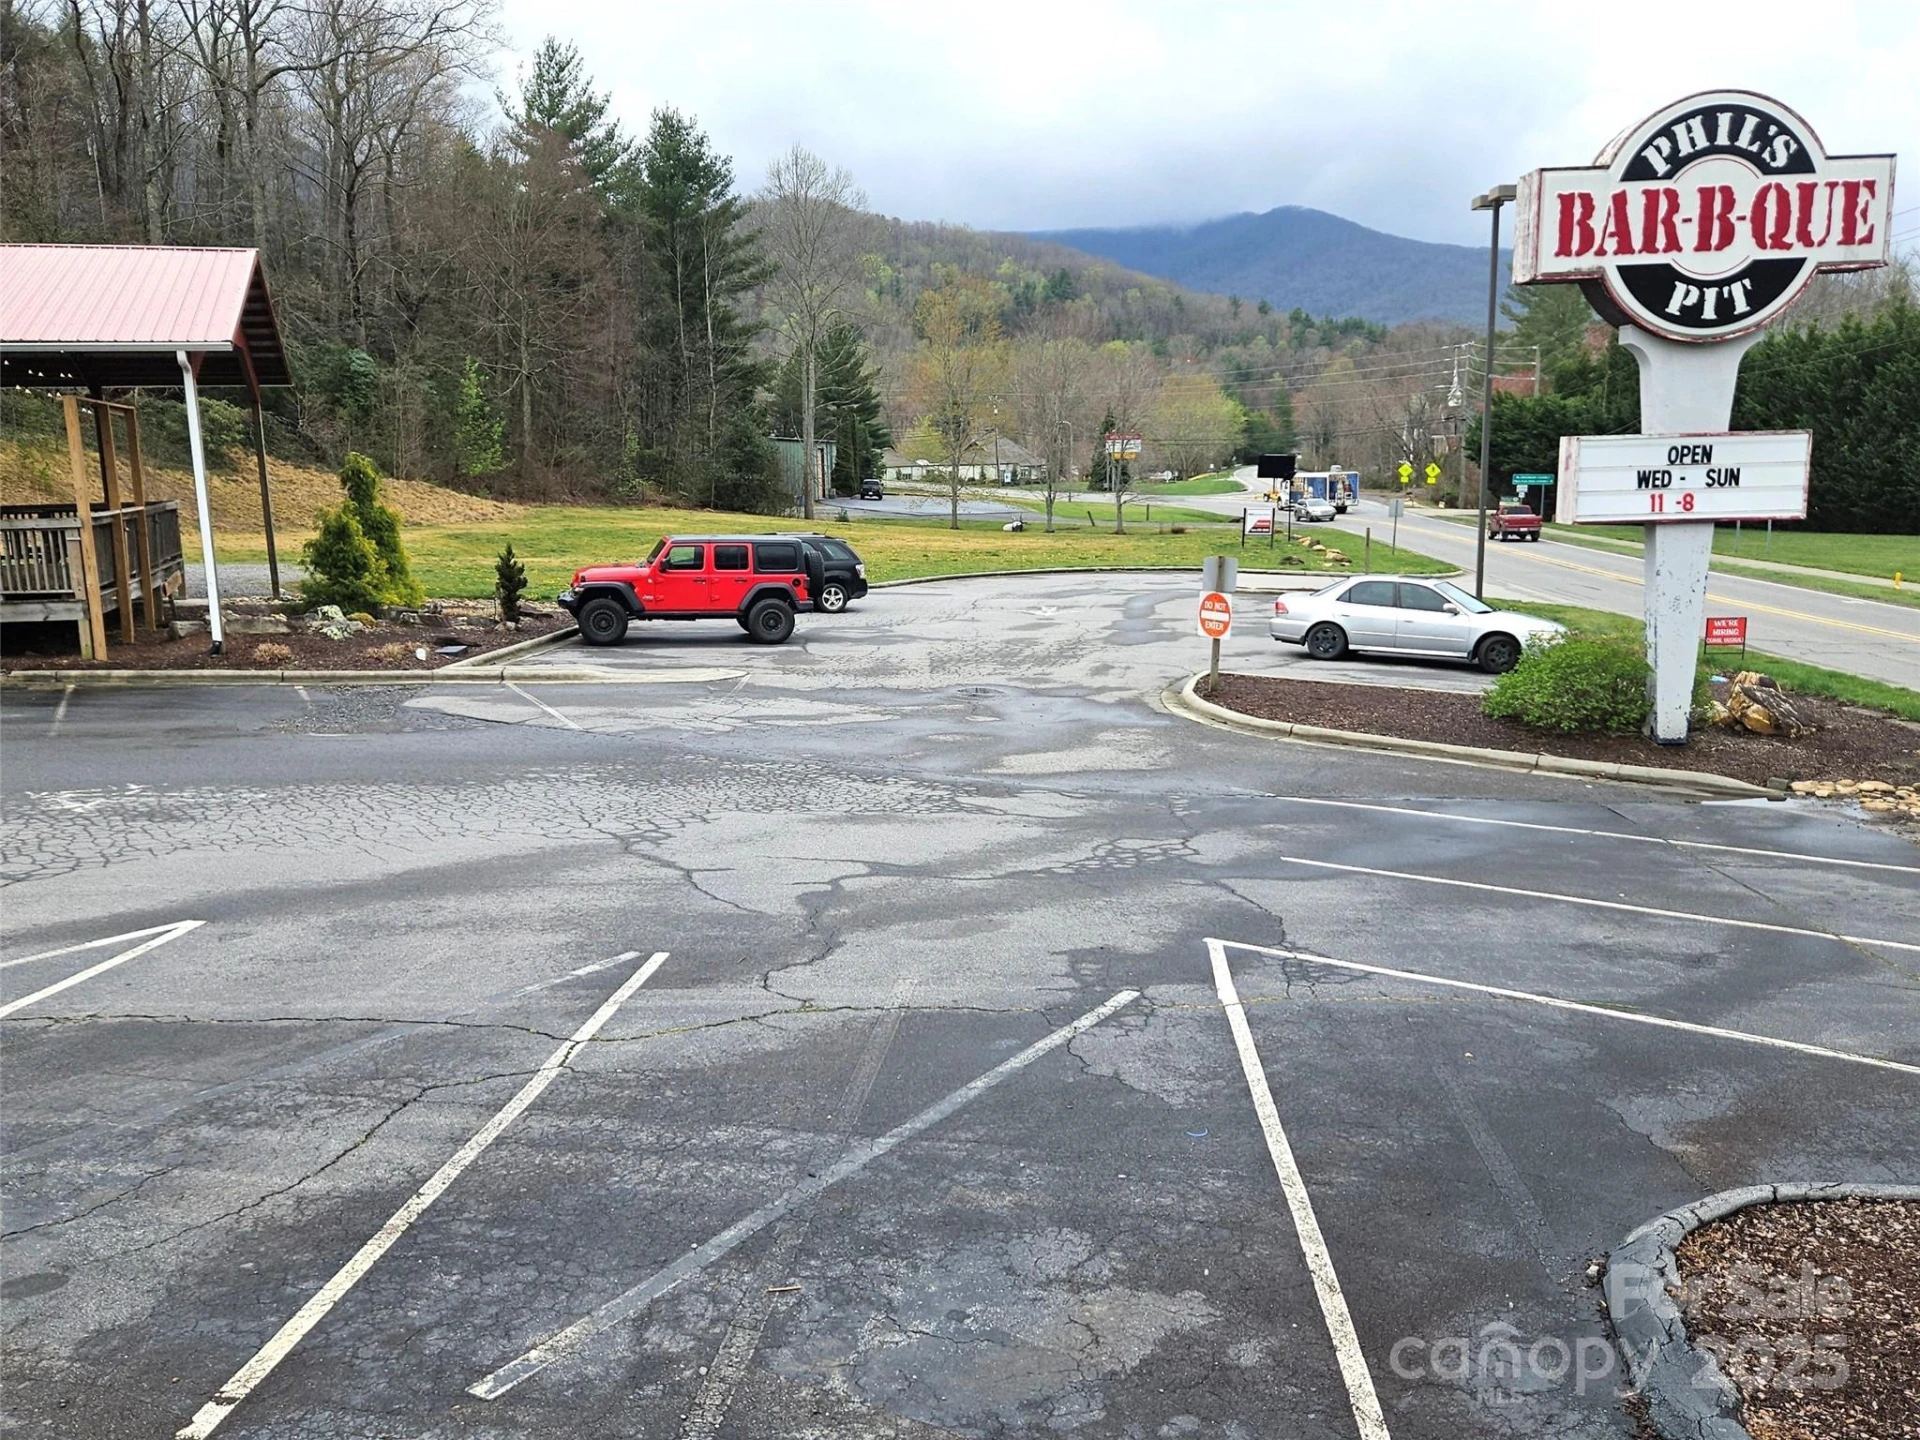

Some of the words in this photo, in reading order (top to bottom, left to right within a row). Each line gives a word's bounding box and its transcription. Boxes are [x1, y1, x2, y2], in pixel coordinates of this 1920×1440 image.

[1641, 111, 1799, 177] PHIL'S
[1554, 180, 1876, 257] BAR-B-QUE
[1665, 278, 1753, 320] PIT
[1667, 445, 1713, 465] OPEN
[1637, 470, 1672, 489] WED
[1705, 468, 1740, 487] SUN
[1650, 493, 1663, 512] 11
[1205, 600, 1213, 608] DO
[1215, 602, 1227, 611] NOT
[1206, 621, 1223, 630] ENTER
[1713, 628, 1739, 636] HIRING
[1714, 619, 1739, 627] WE'RE
